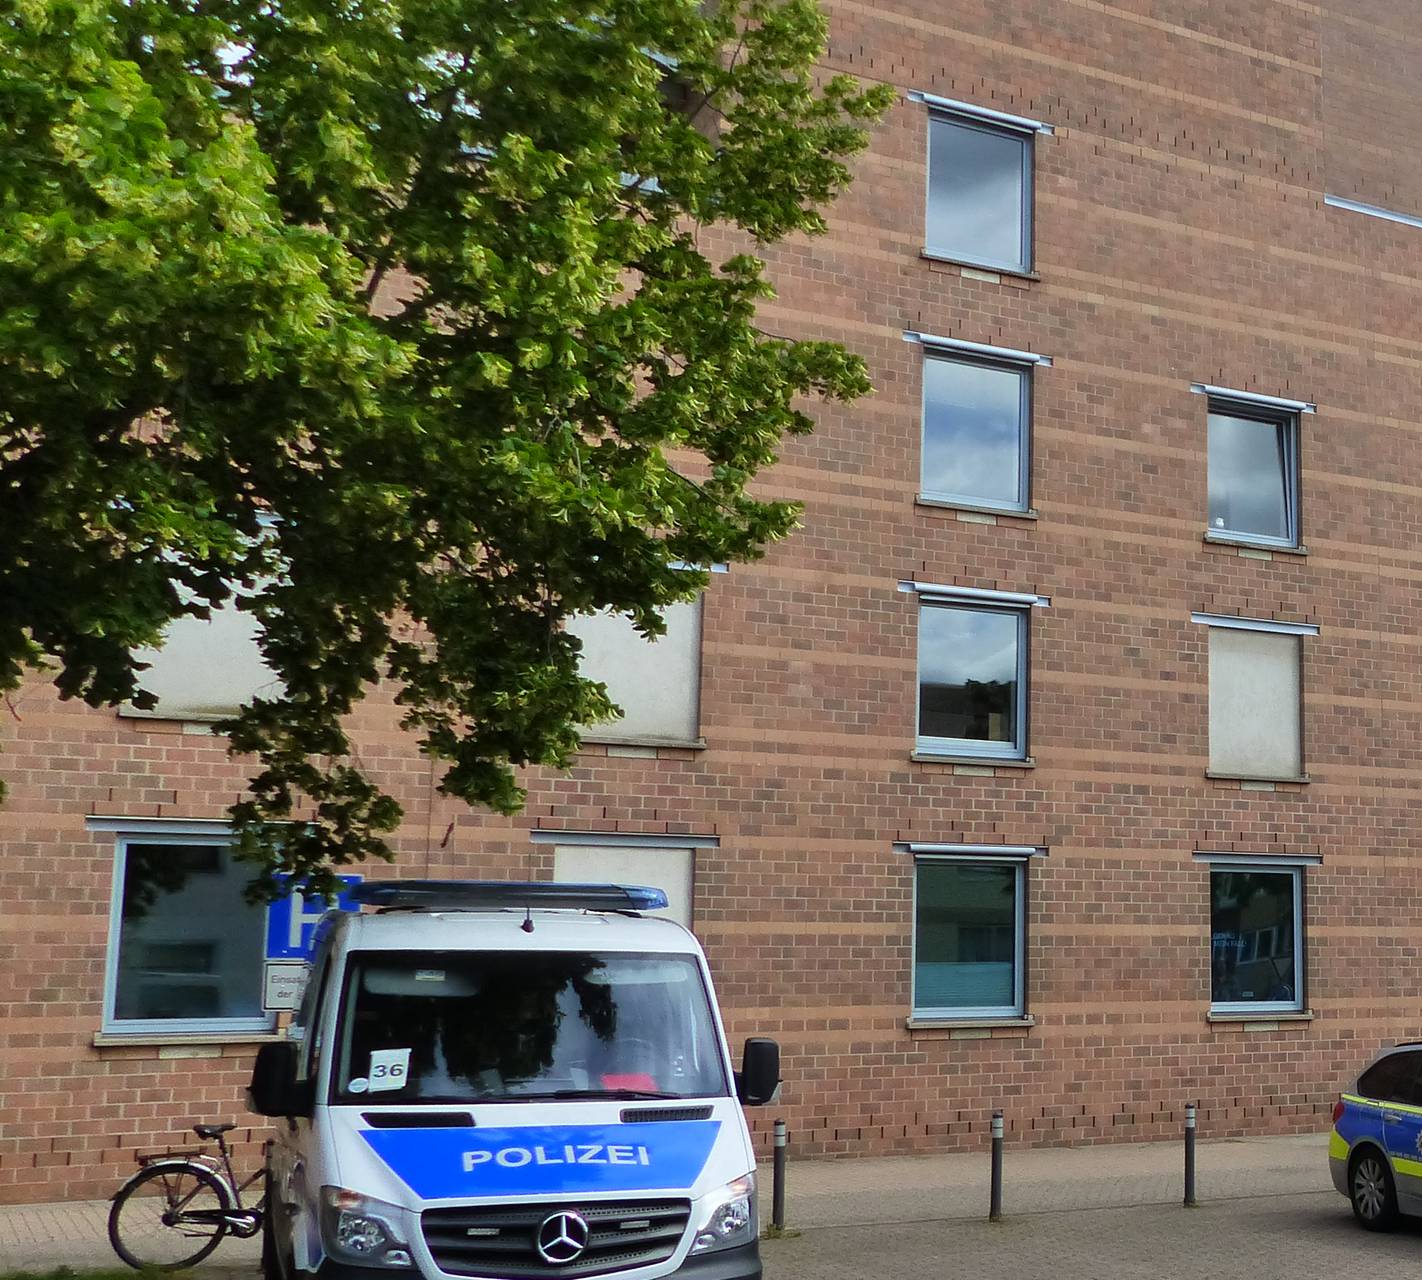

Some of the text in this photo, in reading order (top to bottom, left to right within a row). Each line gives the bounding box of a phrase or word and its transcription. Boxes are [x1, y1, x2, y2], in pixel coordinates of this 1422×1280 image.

[277, 989, 294, 999] der
[373, 1063, 404, 1078] 36
[462, 1144, 650, 1172] POLIZEI
